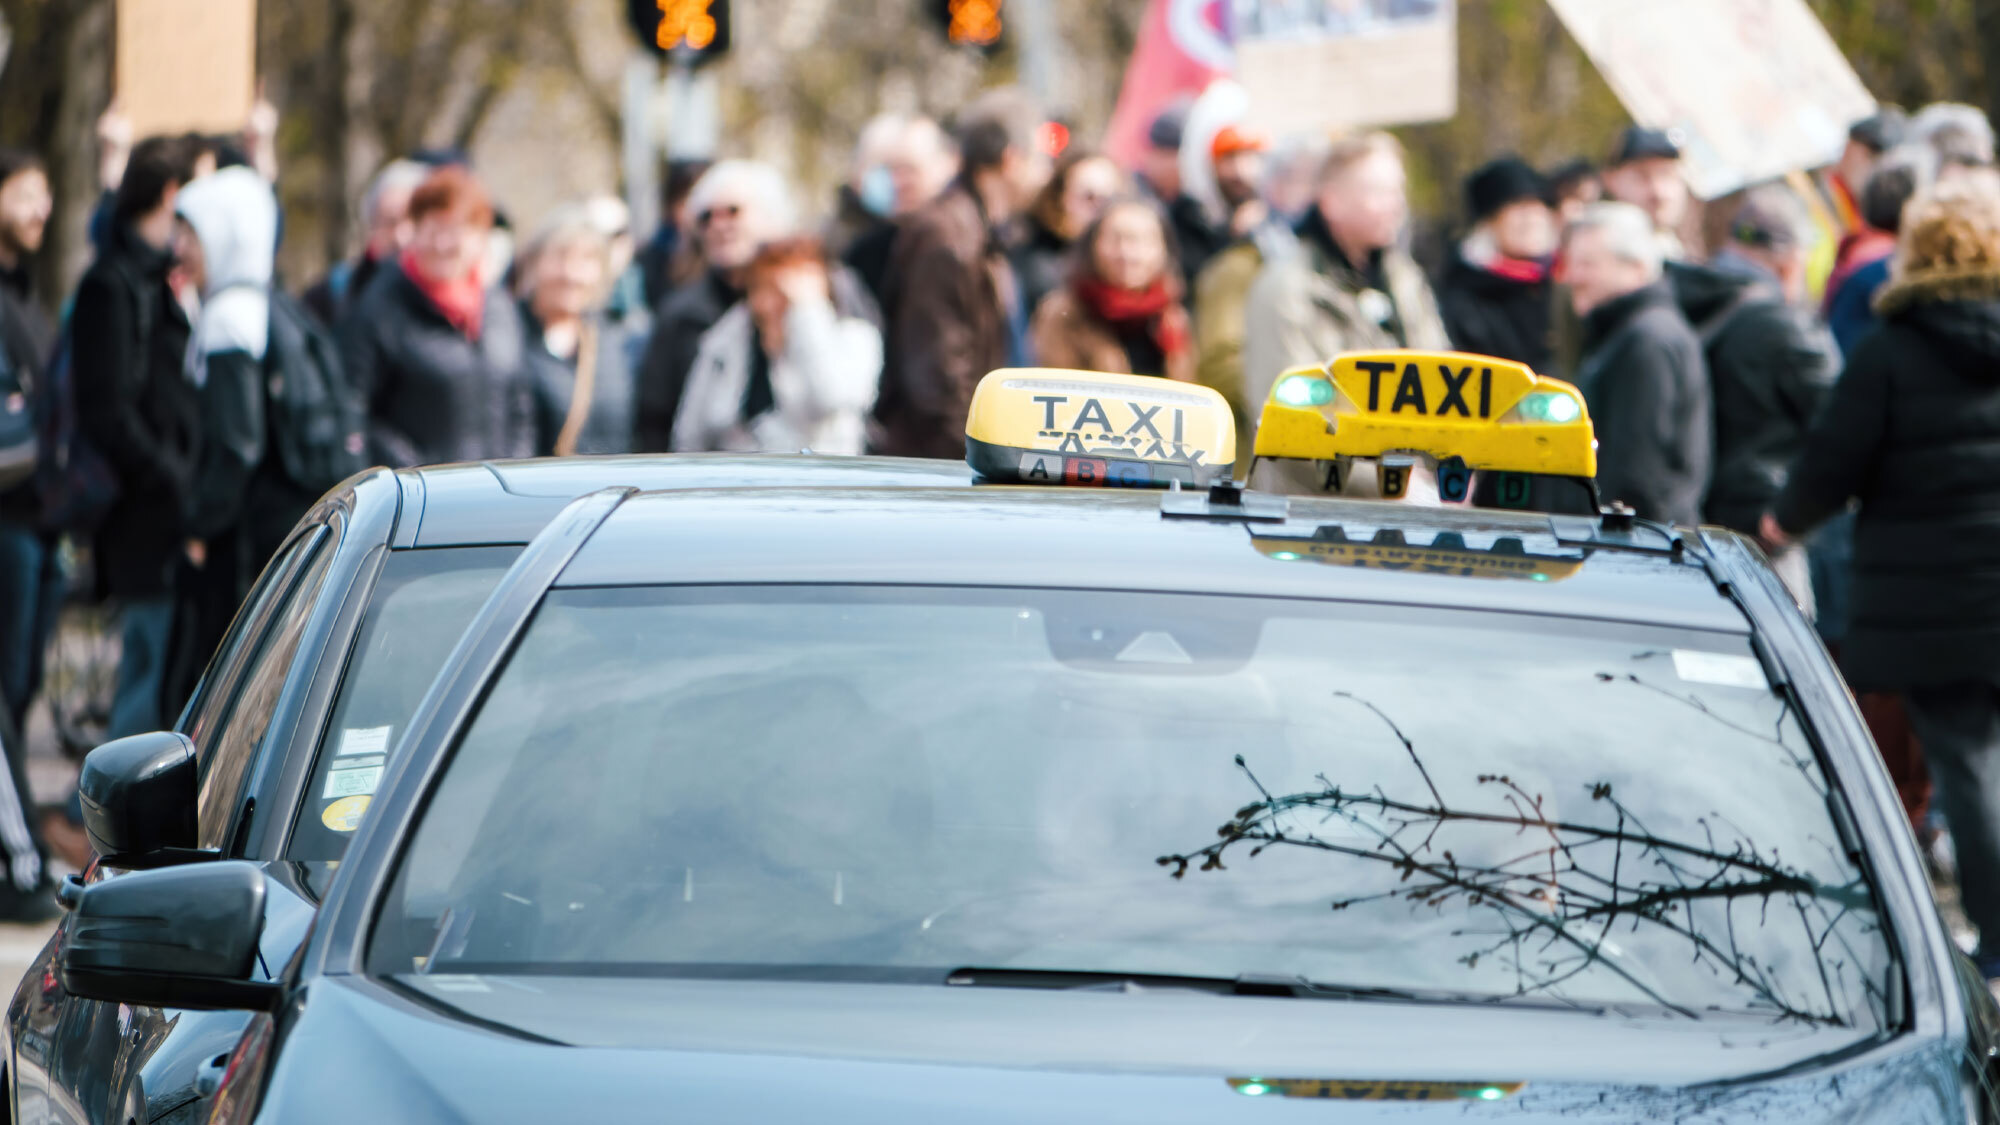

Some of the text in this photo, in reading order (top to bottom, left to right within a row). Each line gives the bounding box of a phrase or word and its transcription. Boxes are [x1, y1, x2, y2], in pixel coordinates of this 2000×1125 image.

[1355, 361, 1492, 419] TAXI
[1033, 396, 1183, 443] TAXI
[1029, 458, 1138, 487] A B C
[1324, 464, 1524, 502] A B C D
